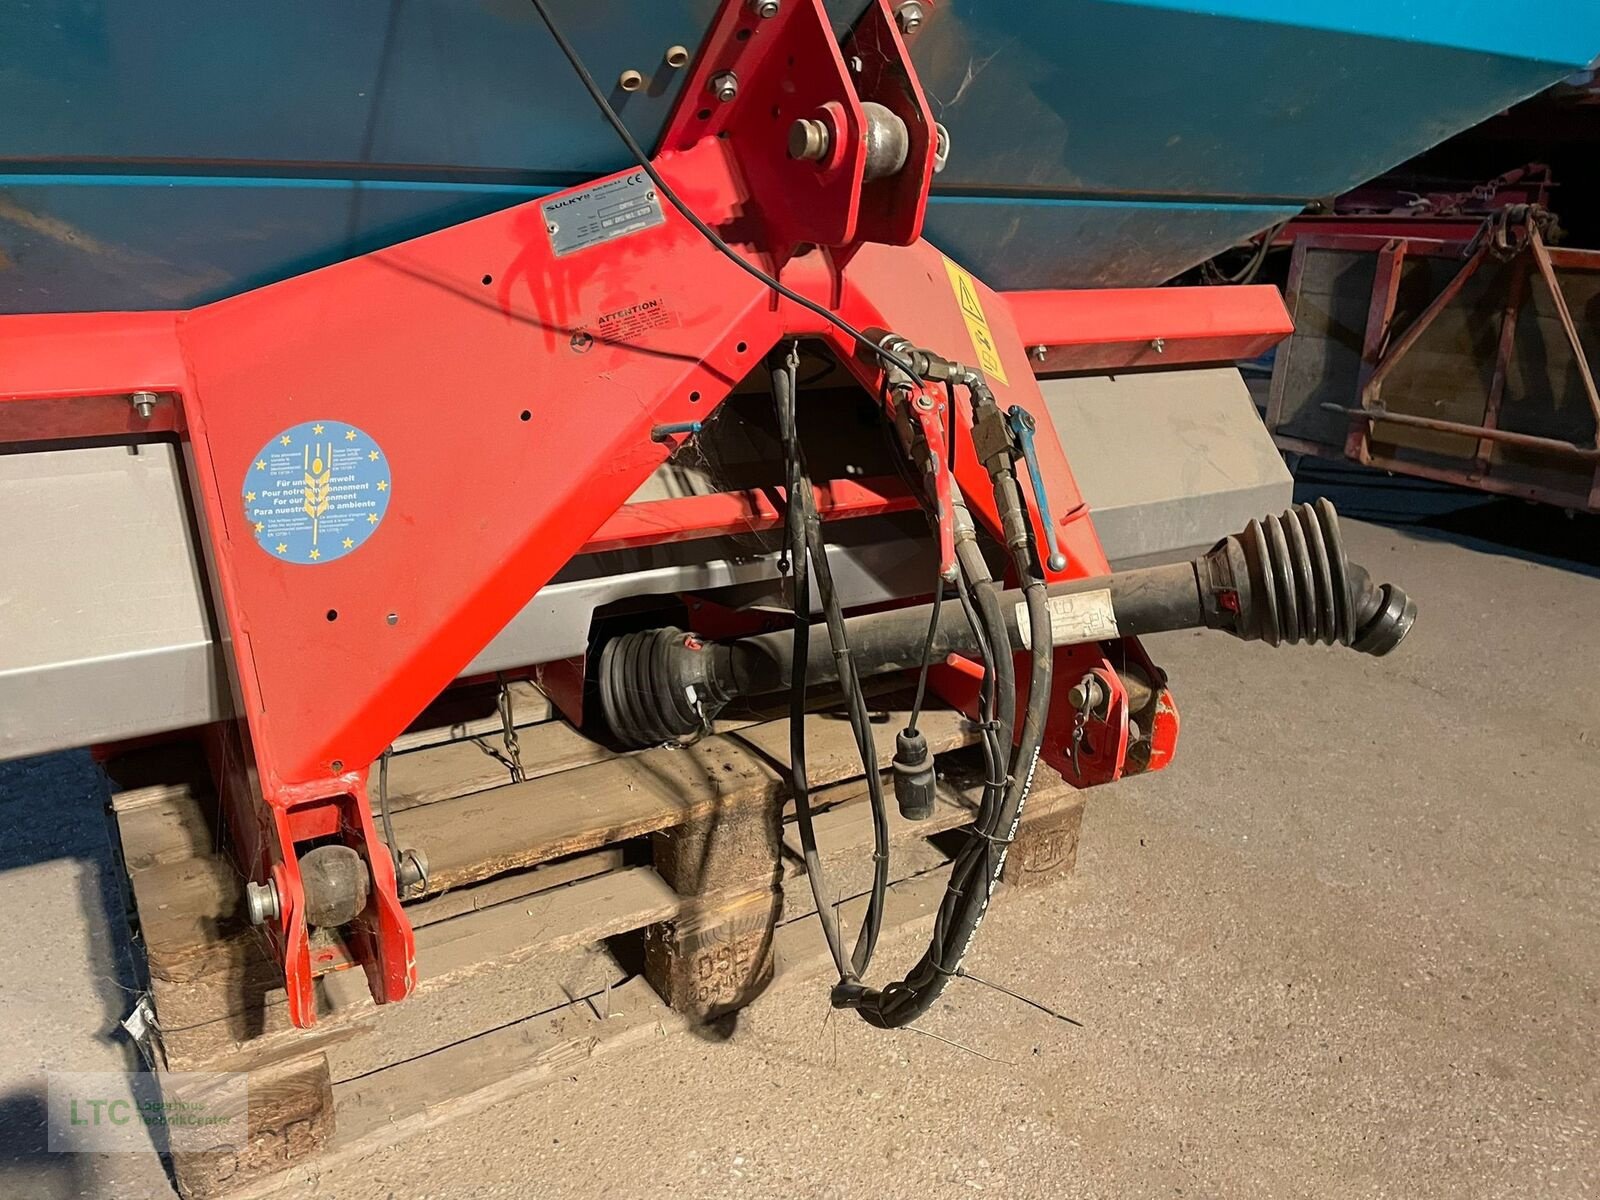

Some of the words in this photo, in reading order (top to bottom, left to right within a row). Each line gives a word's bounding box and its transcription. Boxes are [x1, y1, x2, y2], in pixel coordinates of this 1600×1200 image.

[546, 195, 583, 211] SULKY
[598, 299, 657, 325] ATTENTION
[276, 479, 290, 487] Für
[261, 489, 280, 498] Pour
[282, 486, 305, 496] notre
[253, 508, 273, 517] Para
[275, 504, 307, 514] nuestro
[336, 499, 376, 510] ambiente
[273, 498, 287, 506] For
[289, 497, 303, 505] our
